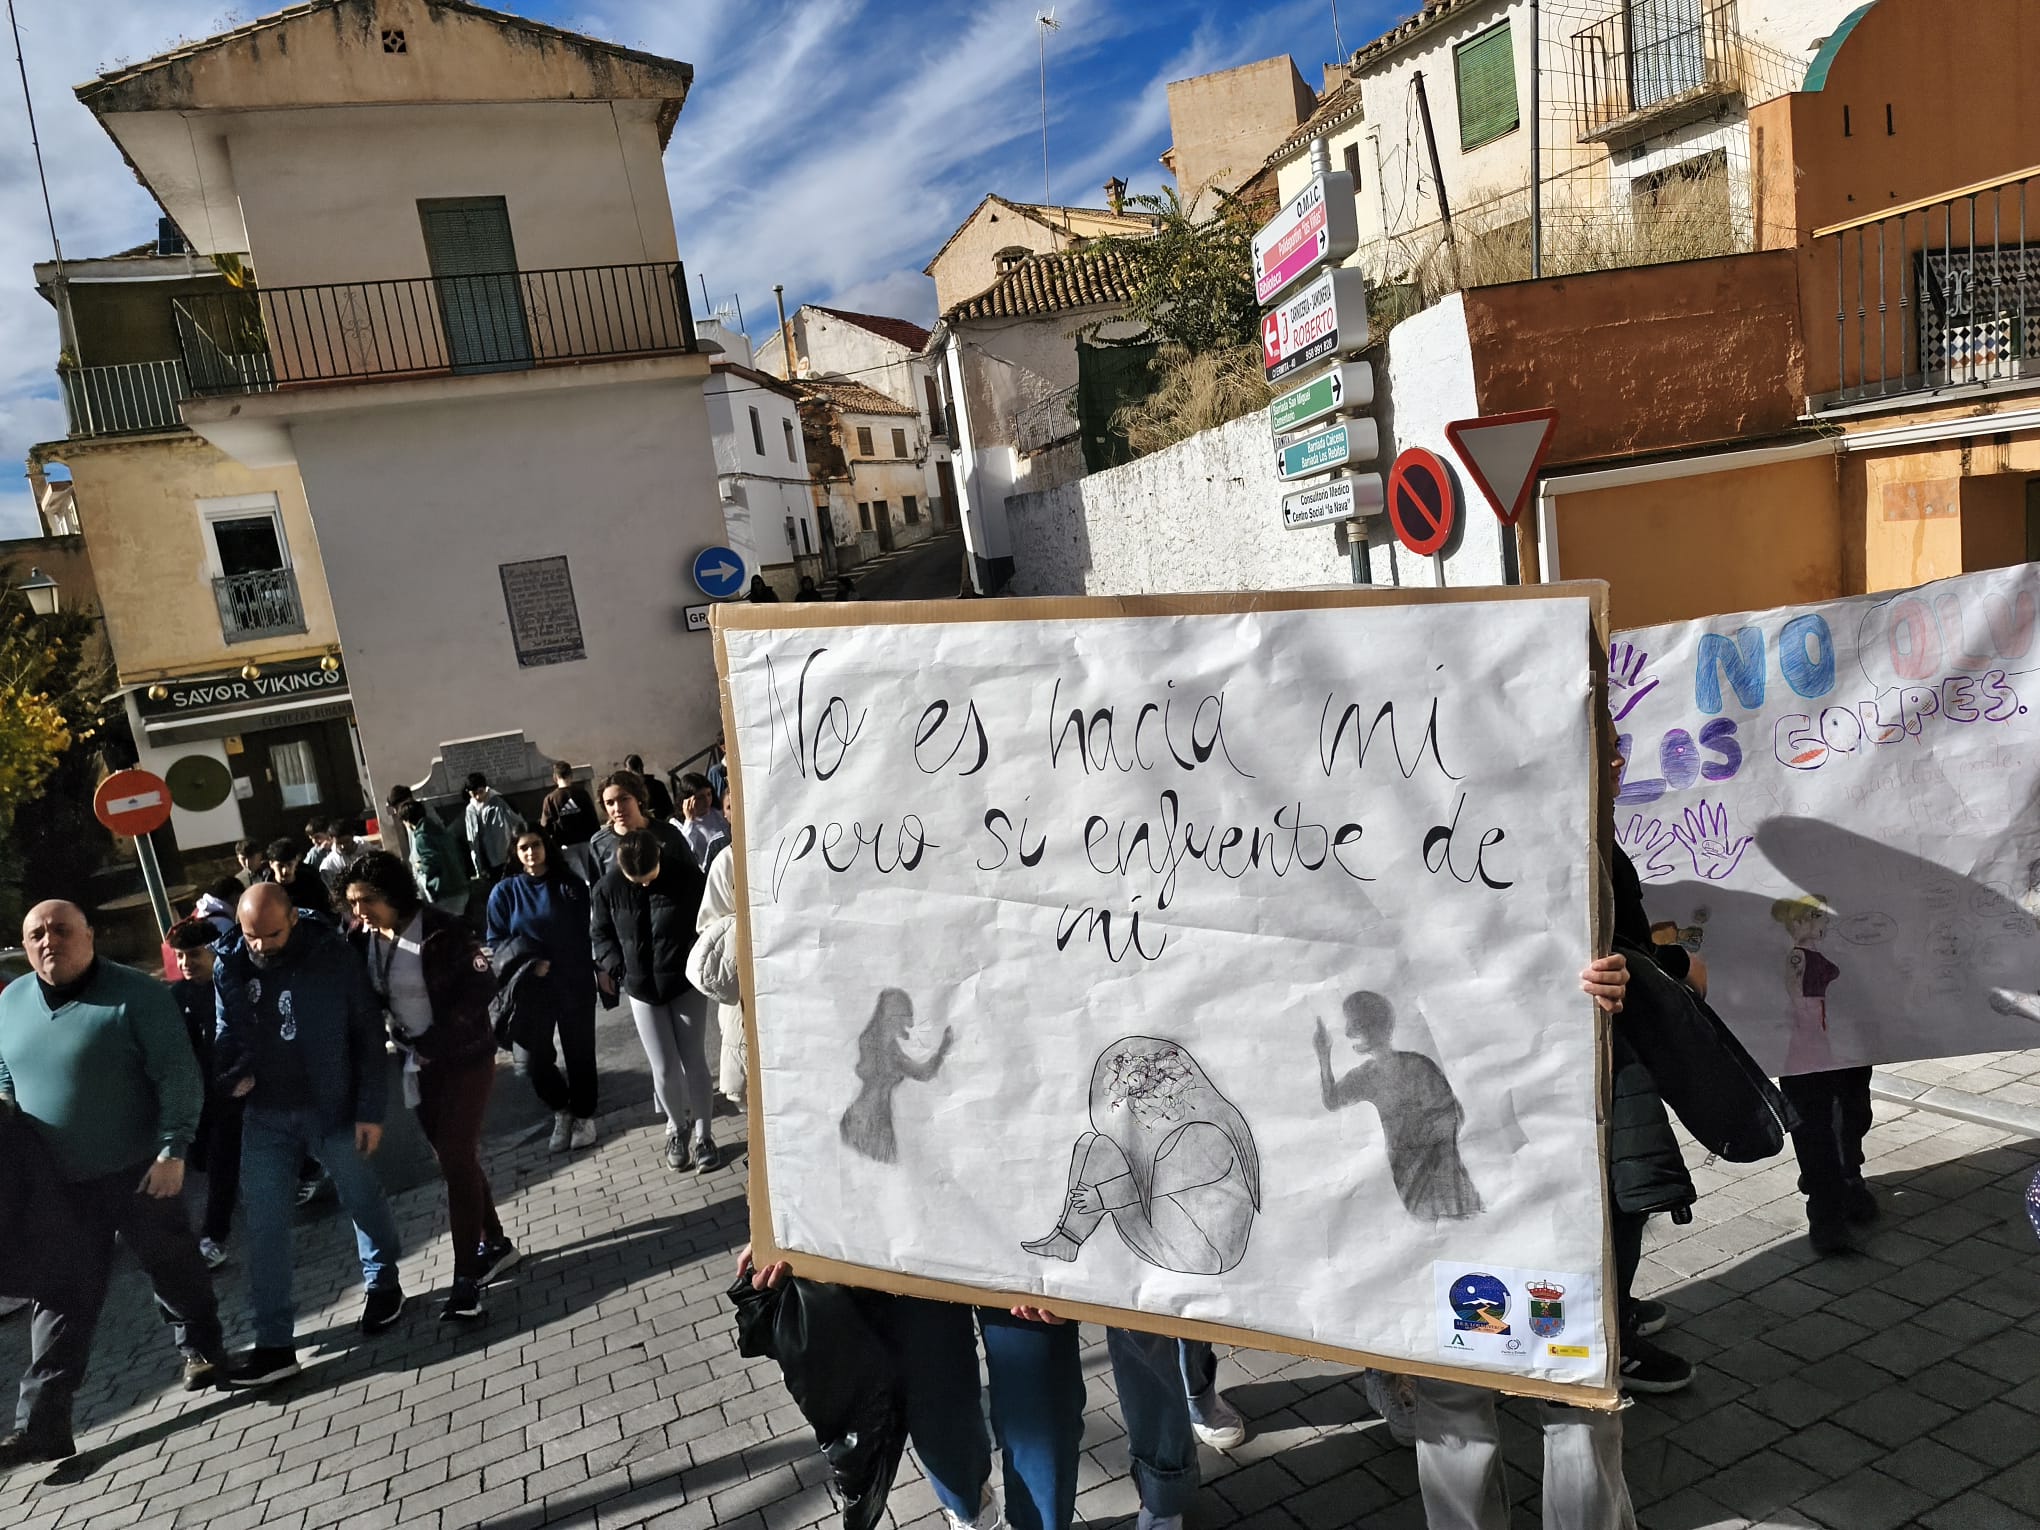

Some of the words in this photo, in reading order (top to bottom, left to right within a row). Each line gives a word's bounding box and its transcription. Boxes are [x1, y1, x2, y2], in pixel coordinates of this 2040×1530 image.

[1259, 270, 1281, 298] Biblioteca
[1293, 307, 1334, 349] ROBERTO
[1273, 400, 1288, 416] Barriada
[1296, 388, 1311, 406] Miguel
[1274, 410, 1296, 428] Cementerio
[1307, 437, 1326, 453] Barriada
[1301, 452, 1319, 469] Barriada
[1318, 450, 1328, 463] Los
[1301, 488, 1329, 506] Consultorio
[1292, 511, 1309, 522] Centro
[1308, 504, 1325, 519] Social
[1695, 613, 1836, 715] NO
[766, 647, 868, 781] No
[914, 698, 989, 776] es
[1049, 677, 1257, 780] hacia
[1616, 717, 1742, 806] LOS
[1774, 670, 2028, 770] GOLPES.
[773, 815, 940, 903] pero
[1422, 792, 1513, 889] de
